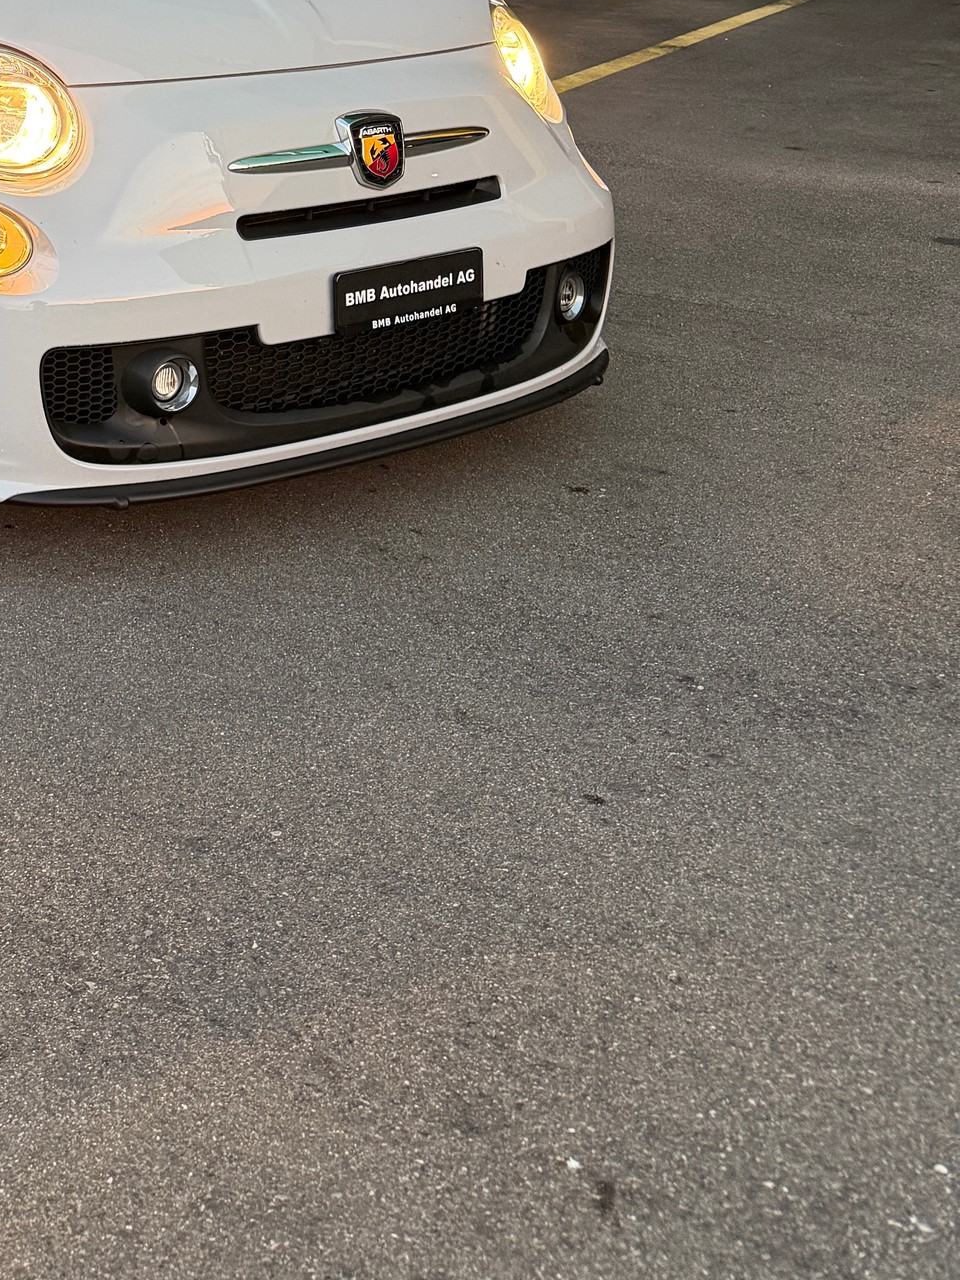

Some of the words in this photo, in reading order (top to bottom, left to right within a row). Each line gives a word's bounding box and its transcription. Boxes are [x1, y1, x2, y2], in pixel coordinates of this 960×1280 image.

[363, 126, 392, 136] ABARTH
[345, 288, 376, 306] BMB
[380, 273, 453, 300] Autohandel
[456, 269, 475, 285] AG
[372, 317, 391, 329] BMB
[394, 305, 443, 325] Autohandel
[445, 303, 457, 314] AG
